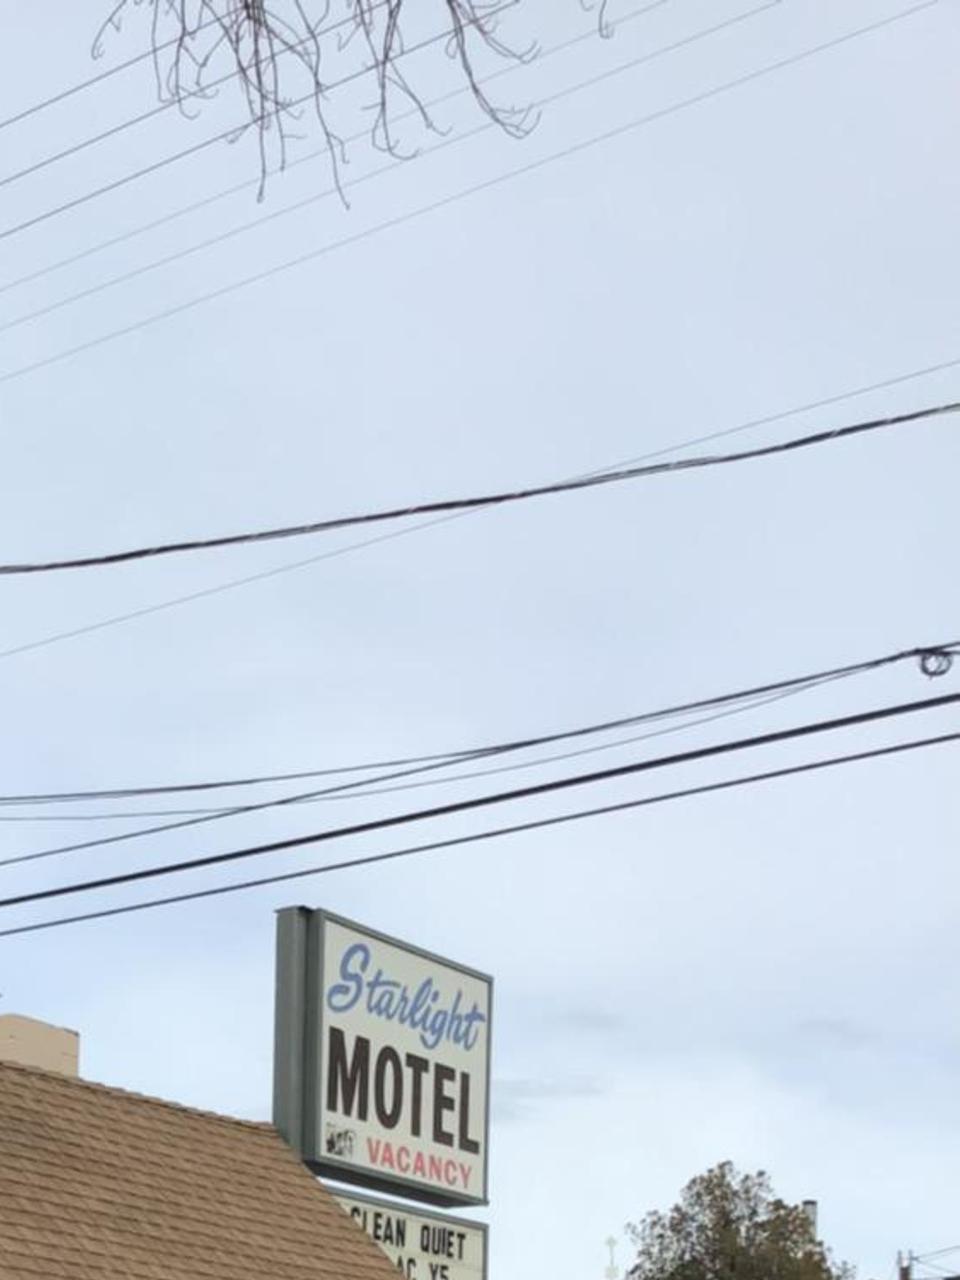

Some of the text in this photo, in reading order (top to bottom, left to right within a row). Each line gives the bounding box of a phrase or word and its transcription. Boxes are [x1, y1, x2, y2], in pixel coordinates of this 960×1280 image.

[326, 942, 486, 1051] Starlight
[326, 1025, 480, 1155] MOTEL
[366, 1137, 472, 1189] VACANCY
[420, 1224, 466, 1260] QUIET
